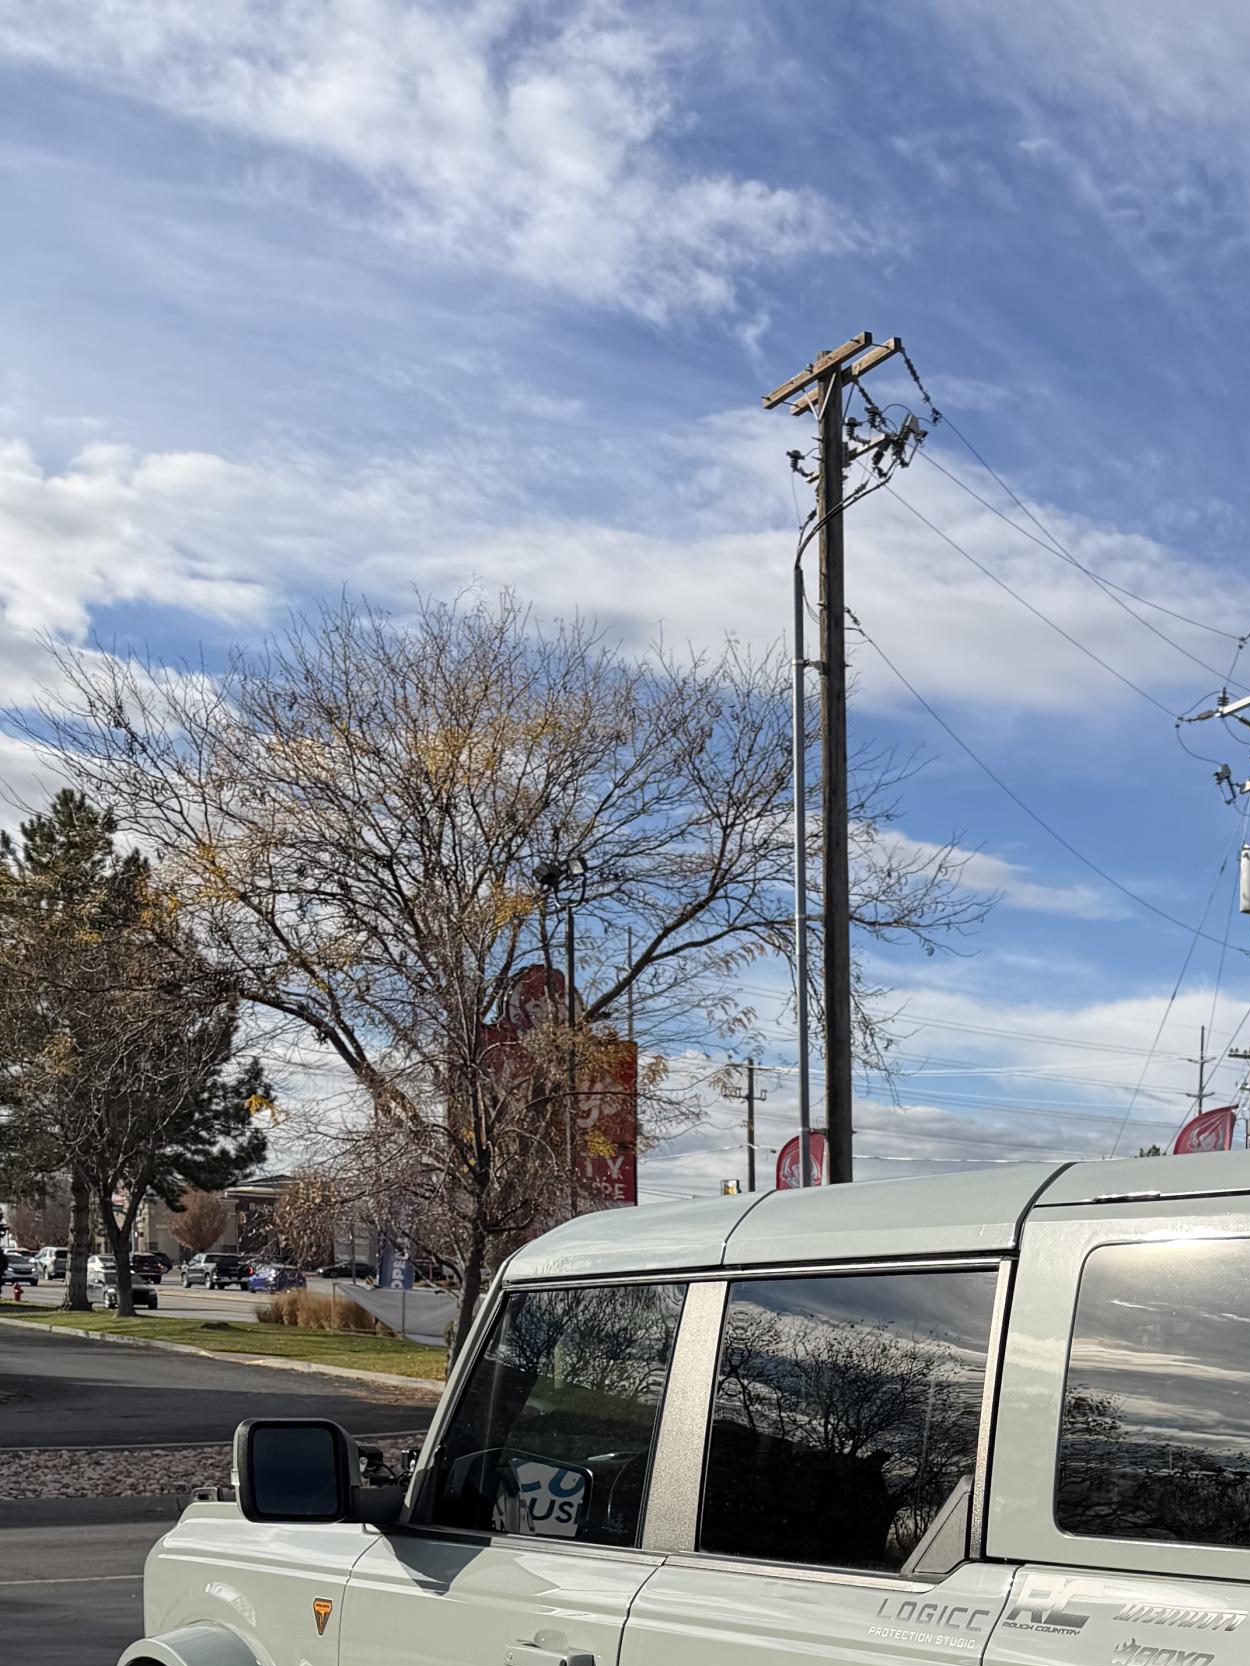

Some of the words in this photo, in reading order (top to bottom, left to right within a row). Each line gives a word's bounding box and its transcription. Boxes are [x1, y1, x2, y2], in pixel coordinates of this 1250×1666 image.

[875, 1598, 991, 1633] LOGICC
[1002, 1621, 1034, 1631] ROUGH
[1034, 1624, 1081, 1636] COUNTRY
[1112, 1601, 1249, 1632] MISHIMOTO
[867, 1626, 933, 1644] PROTECTION
[935, 1635, 976, 1649] STUDIO
